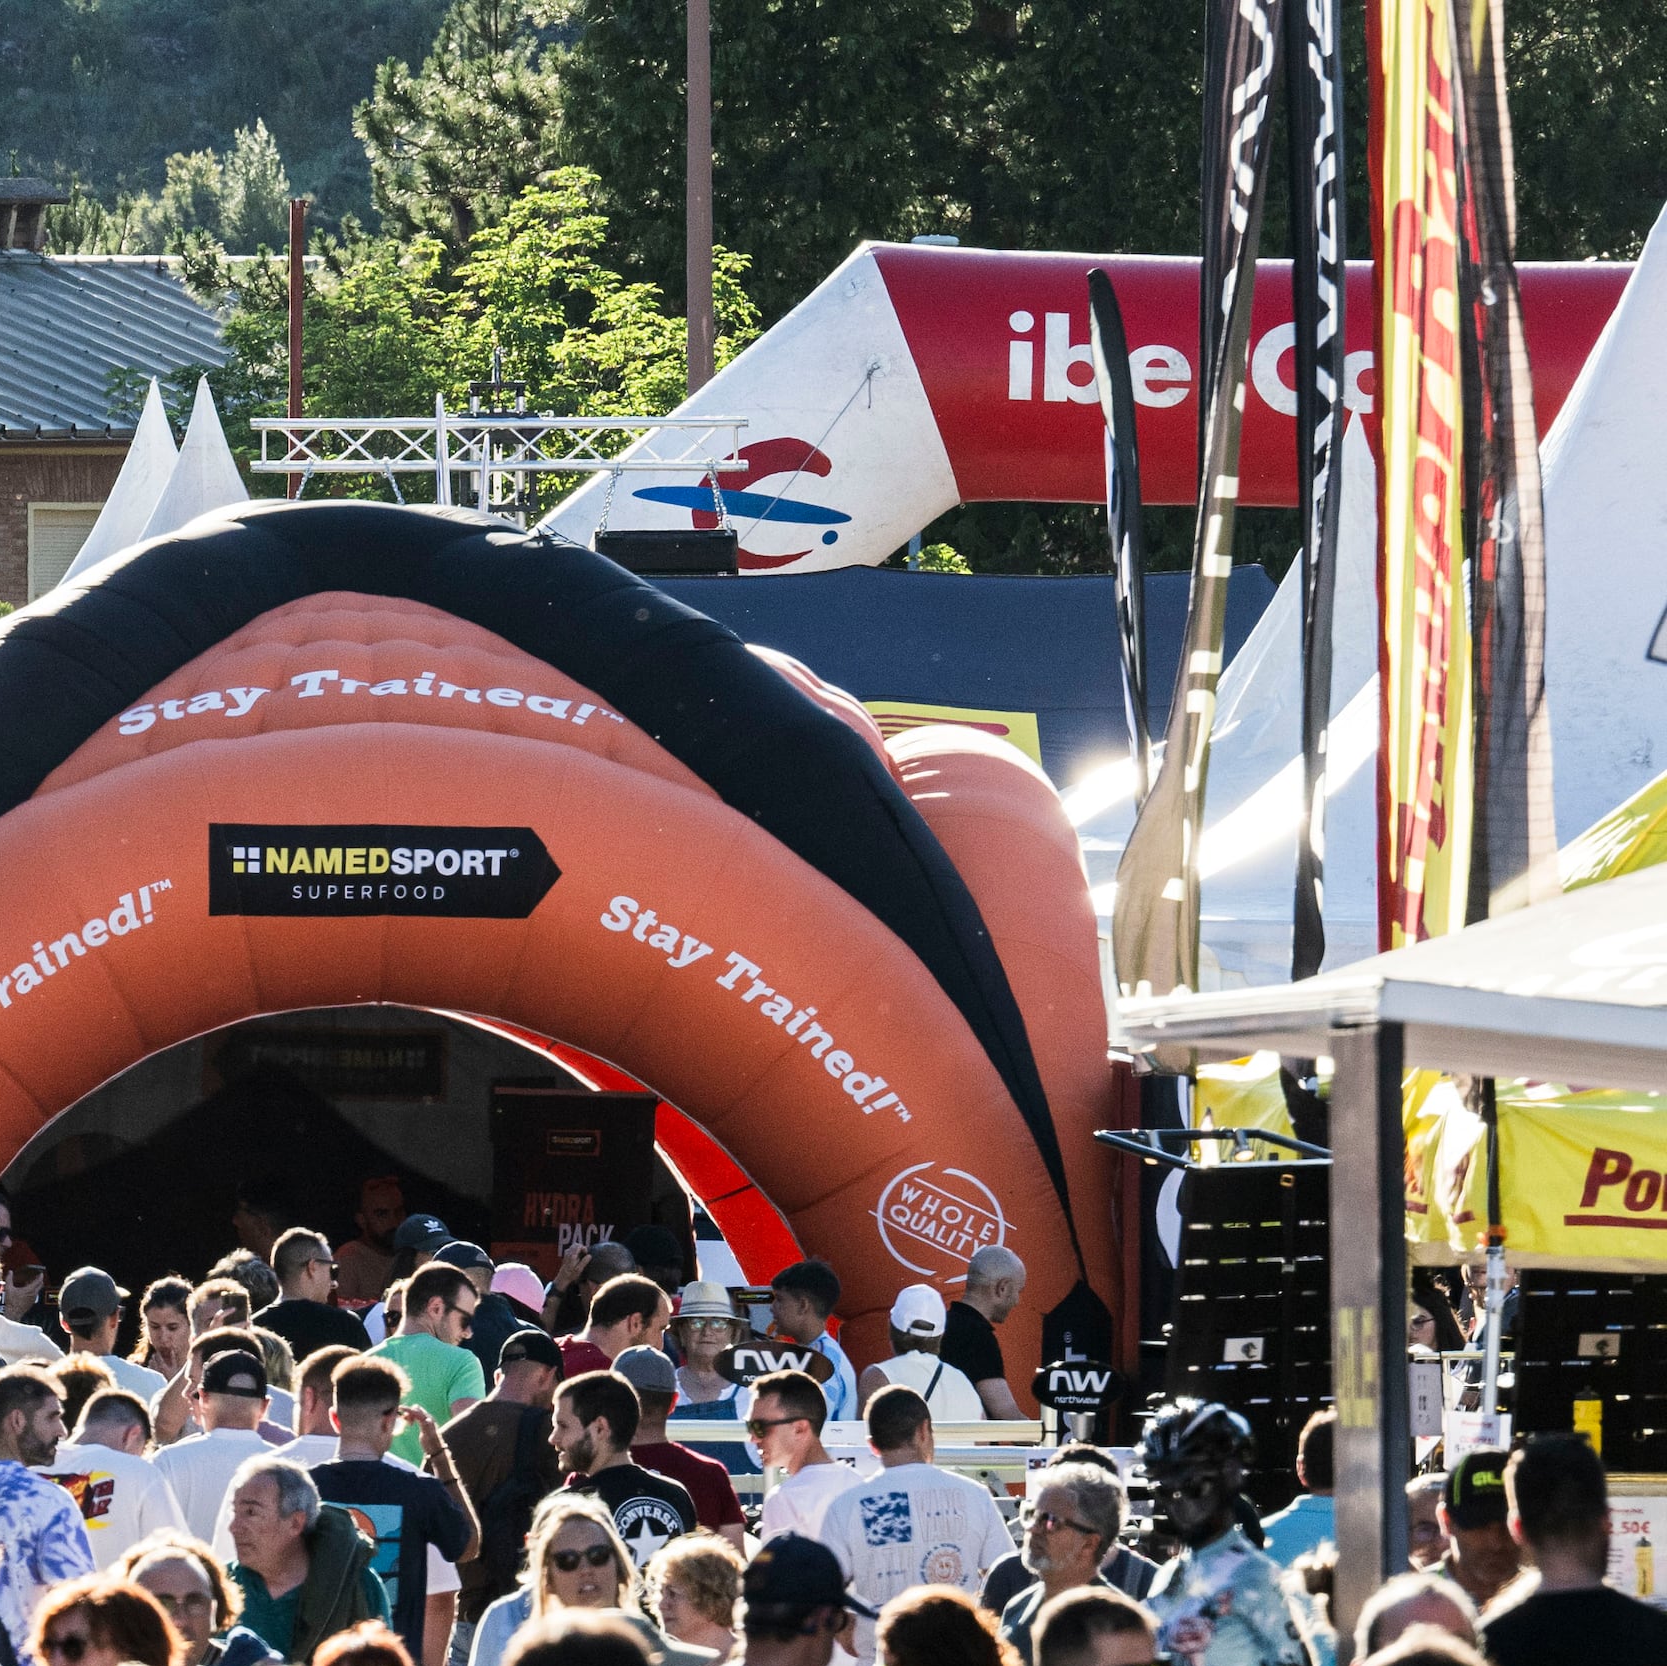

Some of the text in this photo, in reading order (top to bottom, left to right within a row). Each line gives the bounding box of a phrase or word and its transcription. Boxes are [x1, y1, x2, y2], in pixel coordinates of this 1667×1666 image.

[118, 685, 271, 736] Stay
[292, 884, 446, 901] SUPERFOOD
[599, 895, 715, 969] Stay
[1579, 1147, 1667, 1213] Po
[523, 1192, 596, 1229] HYDRA
[889, 1204, 988, 1256] QUALITY
[898, 1182, 996, 1243] WHOLE
[557, 1222, 616, 1258] PACK
[616, 1504, 679, 1540] CONVERSE
